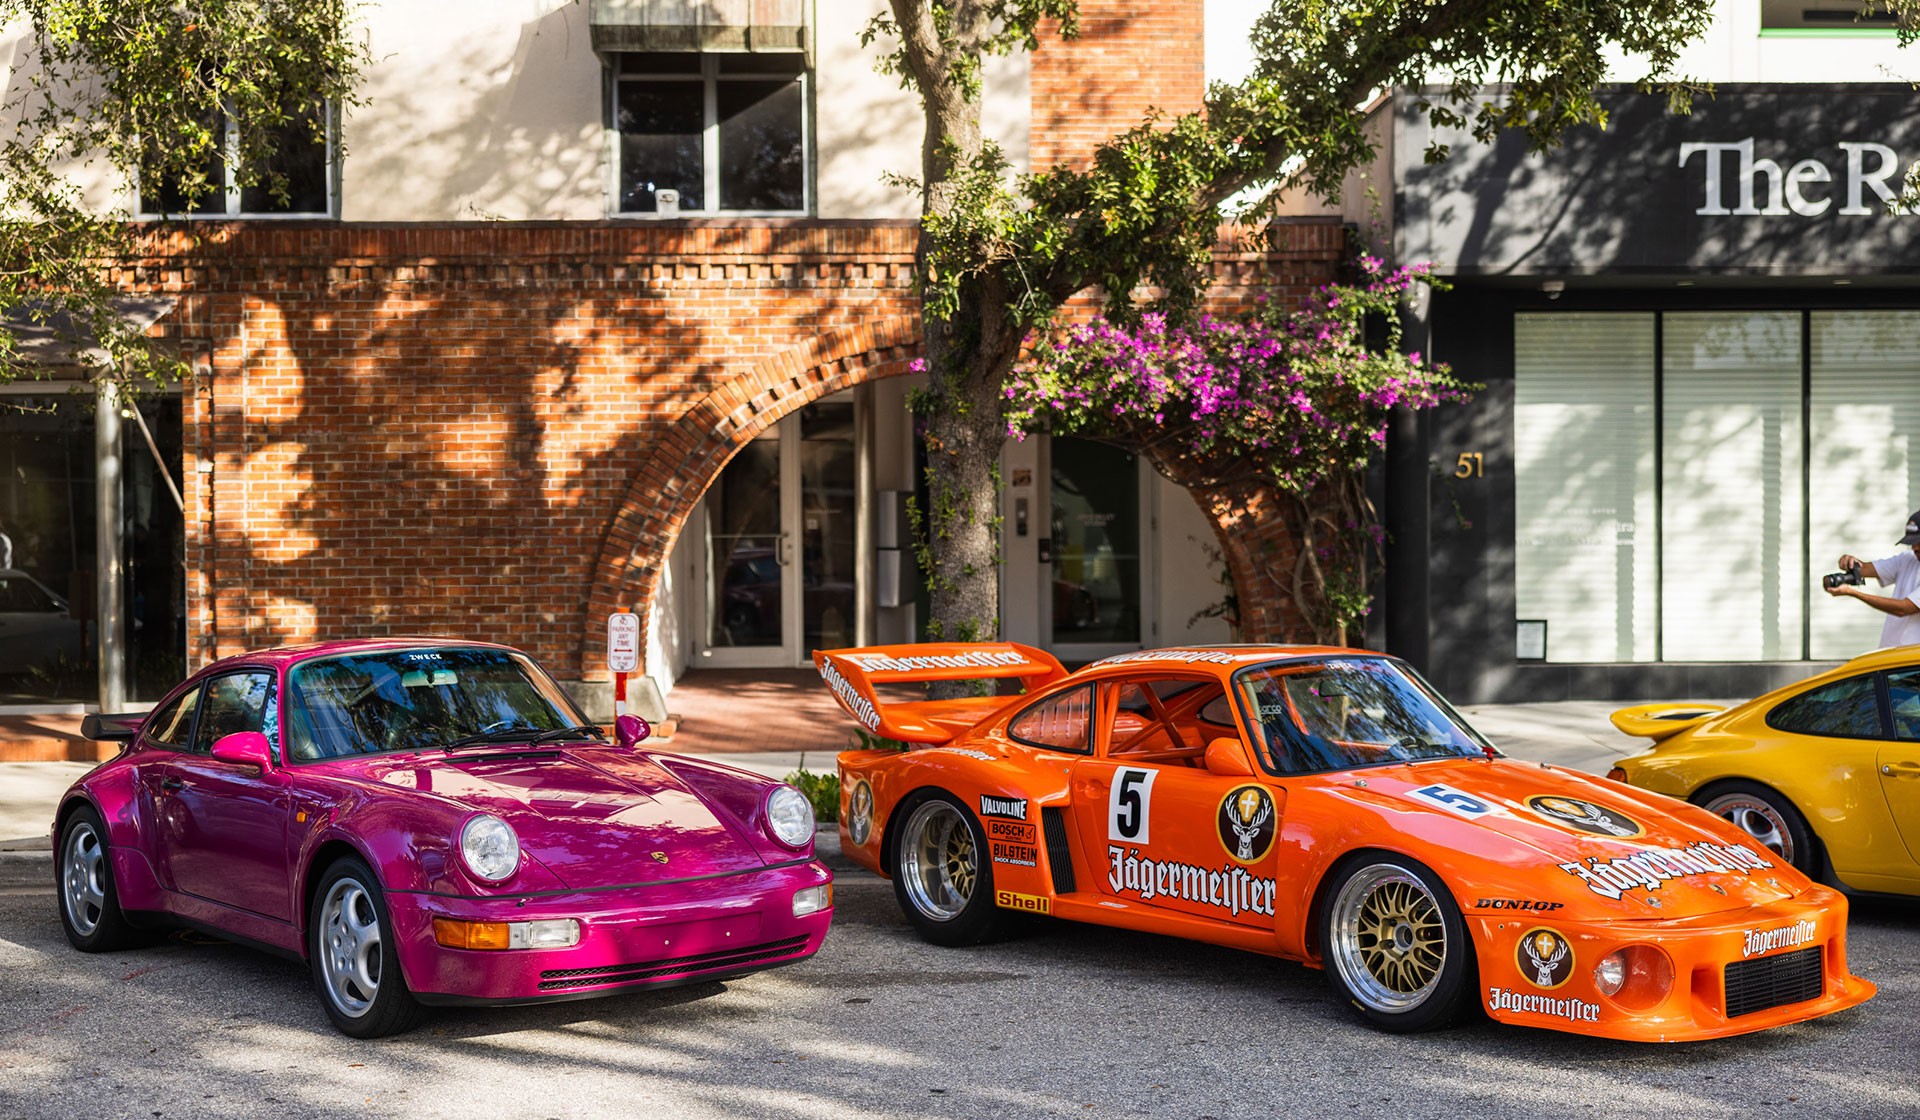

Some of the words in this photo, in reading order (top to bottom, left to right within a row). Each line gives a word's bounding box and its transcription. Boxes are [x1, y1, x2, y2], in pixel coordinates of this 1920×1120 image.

[1678, 136, 1832, 216] The
[1455, 452, 1483, 478] 51
[409, 653, 442, 661] ZWECK
[981, 795, 1027, 820] VALVOLINE
[1116, 770, 1148, 839] 5
[1417, 786, 1491, 813] 5
[992, 823, 1025, 837] BOSCH
[993, 843, 1038, 861] BILSTEIN
[1009, 859, 1037, 867] ABSORBERS
[998, 892, 1048, 912] Shell
[1475, 898, 1564, 911] DUNLOP
